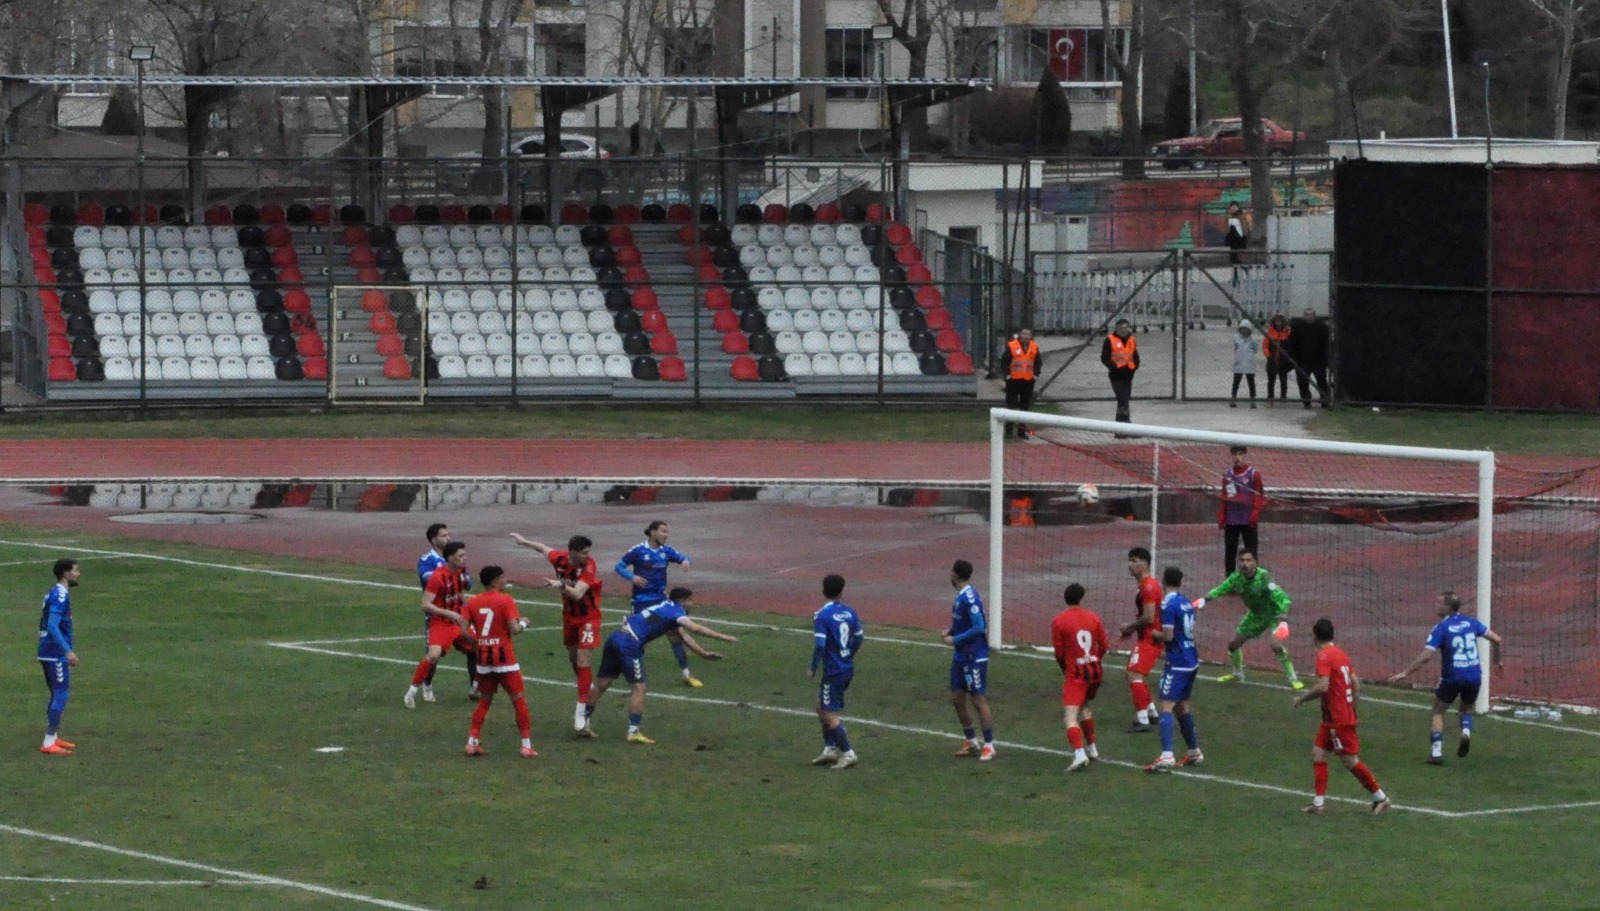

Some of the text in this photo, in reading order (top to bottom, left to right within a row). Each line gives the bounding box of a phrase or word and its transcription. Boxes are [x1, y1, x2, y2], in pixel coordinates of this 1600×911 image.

[315, 245, 322, 254] B
[322, 267, 329, 275] C
[349, 354, 358, 363] G
[357, 377, 365, 386] H
[478, 607, 494, 637] 7
[581, 631, 594, 644] 75
[839, 621, 850, 649] 8
[1076, 629, 1092, 657] 9
[1451, 632, 1478, 661] 25
